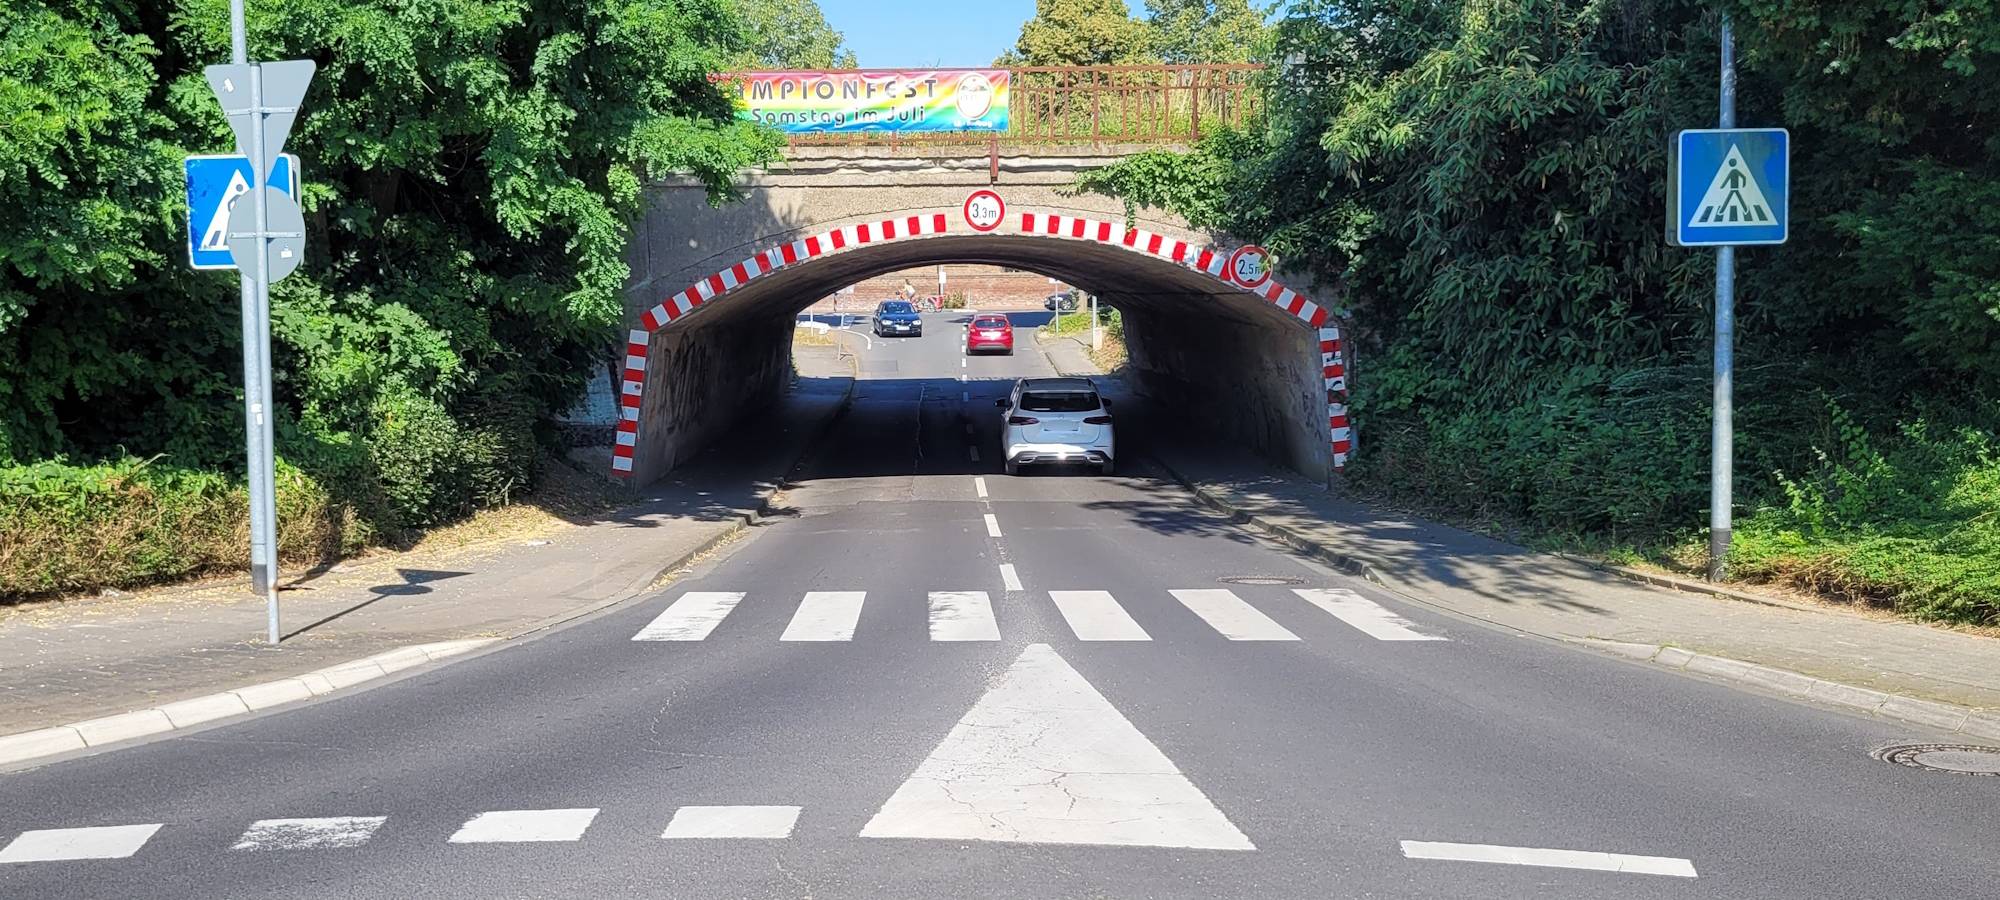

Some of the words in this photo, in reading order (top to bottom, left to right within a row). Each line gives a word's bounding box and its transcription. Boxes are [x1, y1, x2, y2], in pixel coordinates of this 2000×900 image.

[751, 108, 846, 126] Samstag
[854, 107, 878, 122] im
[887, 105, 924, 121] Juli
